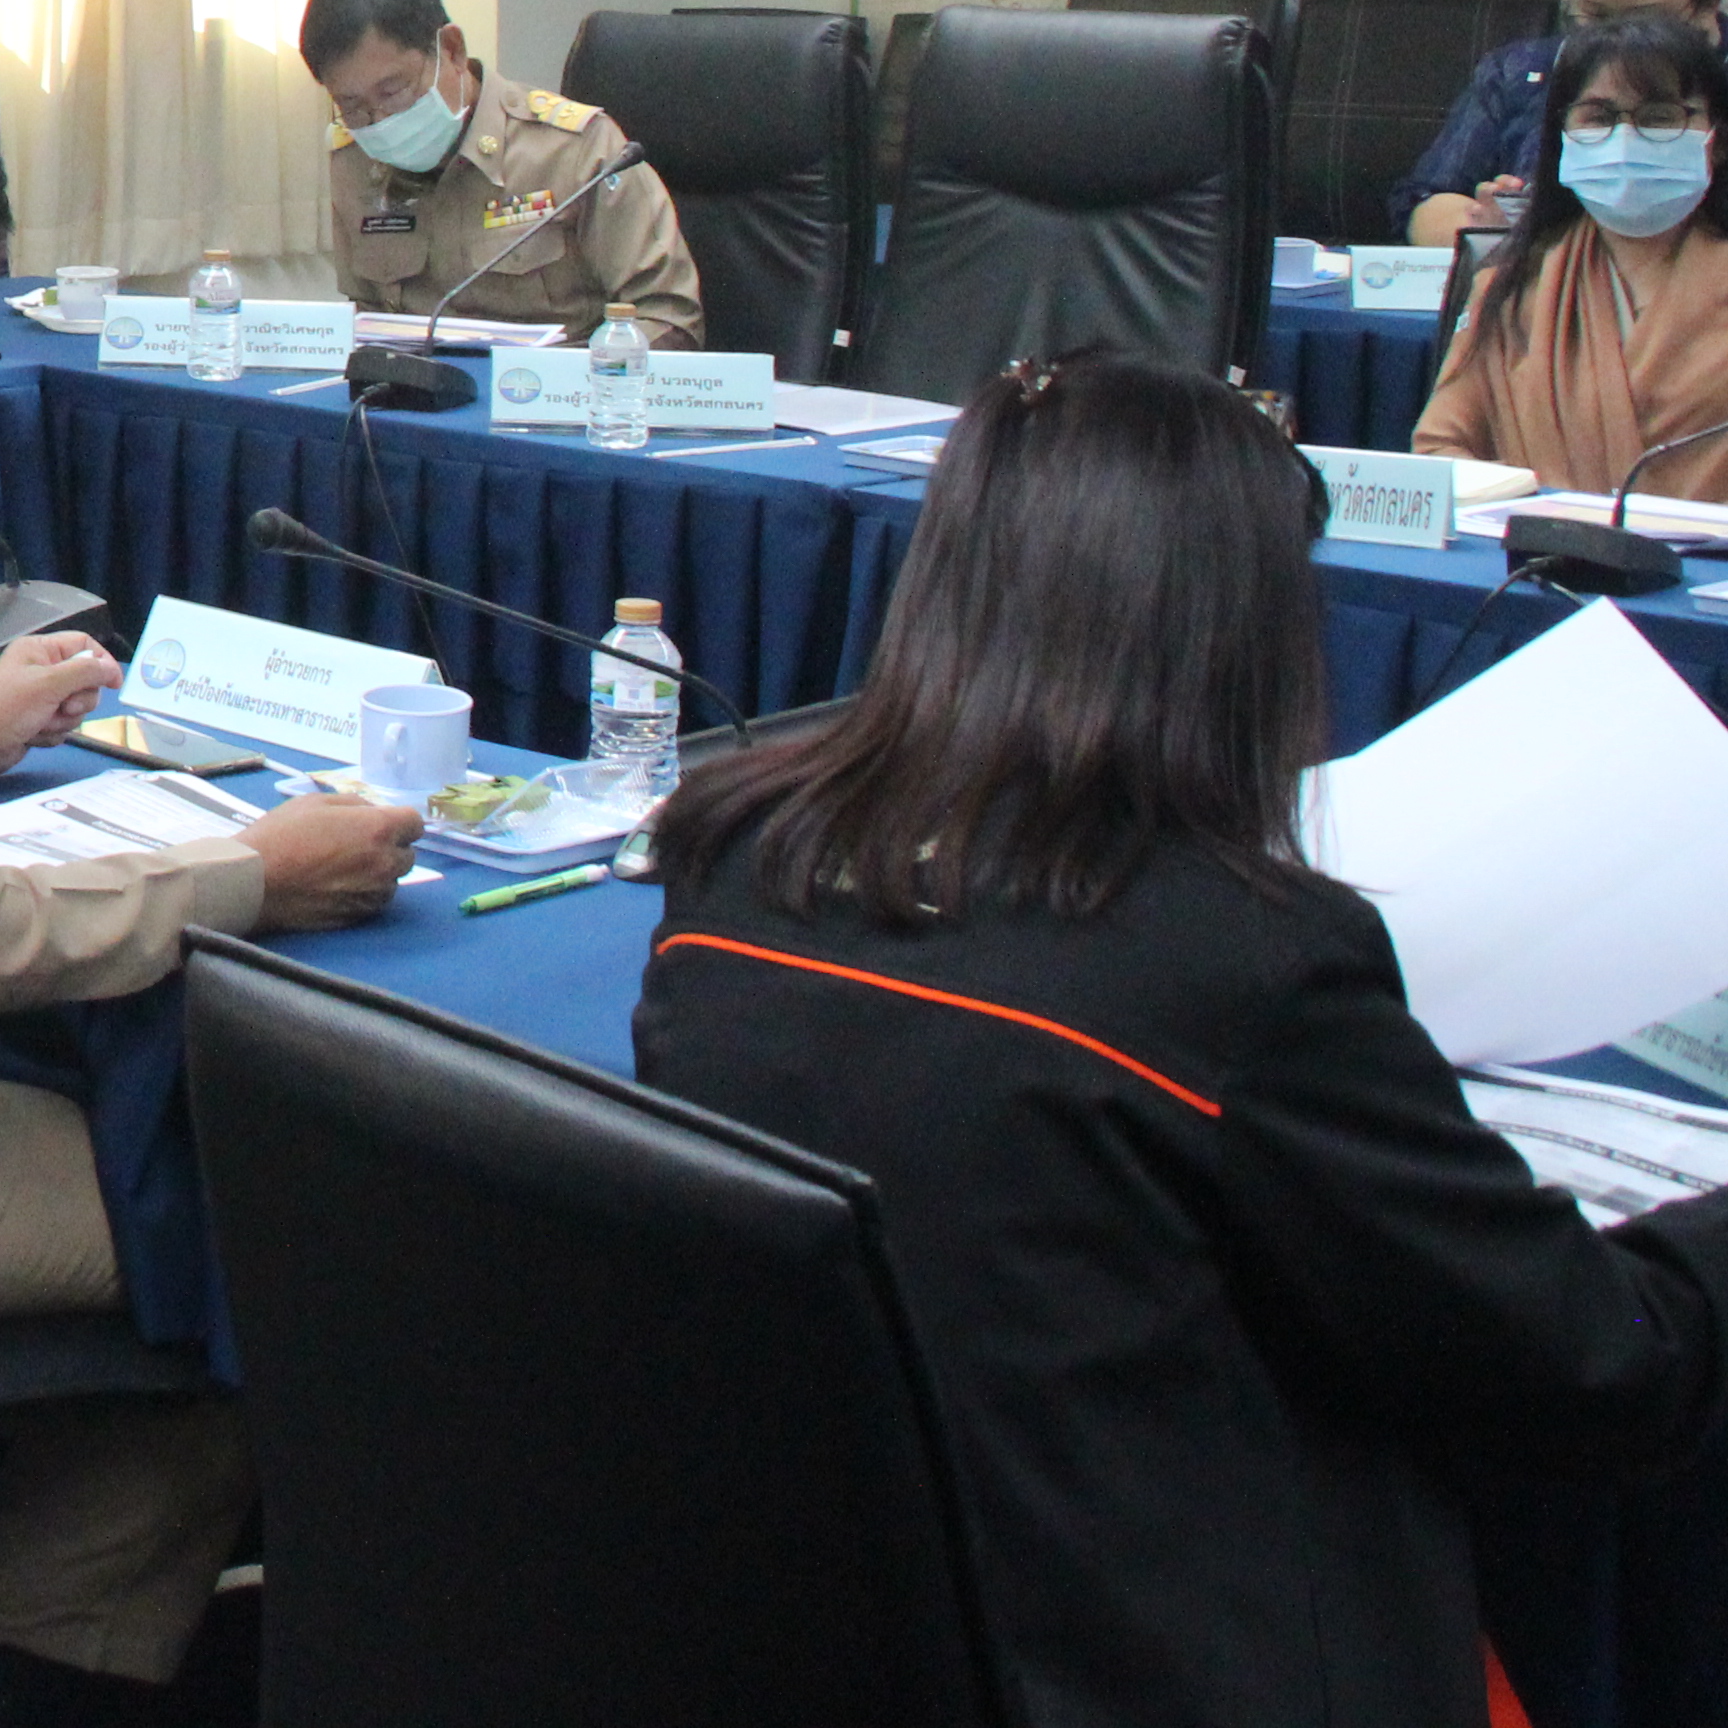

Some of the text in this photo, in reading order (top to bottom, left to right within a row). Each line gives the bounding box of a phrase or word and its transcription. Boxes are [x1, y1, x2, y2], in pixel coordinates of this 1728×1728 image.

[263, 647, 333, 686] ผู้อำนวยการ
